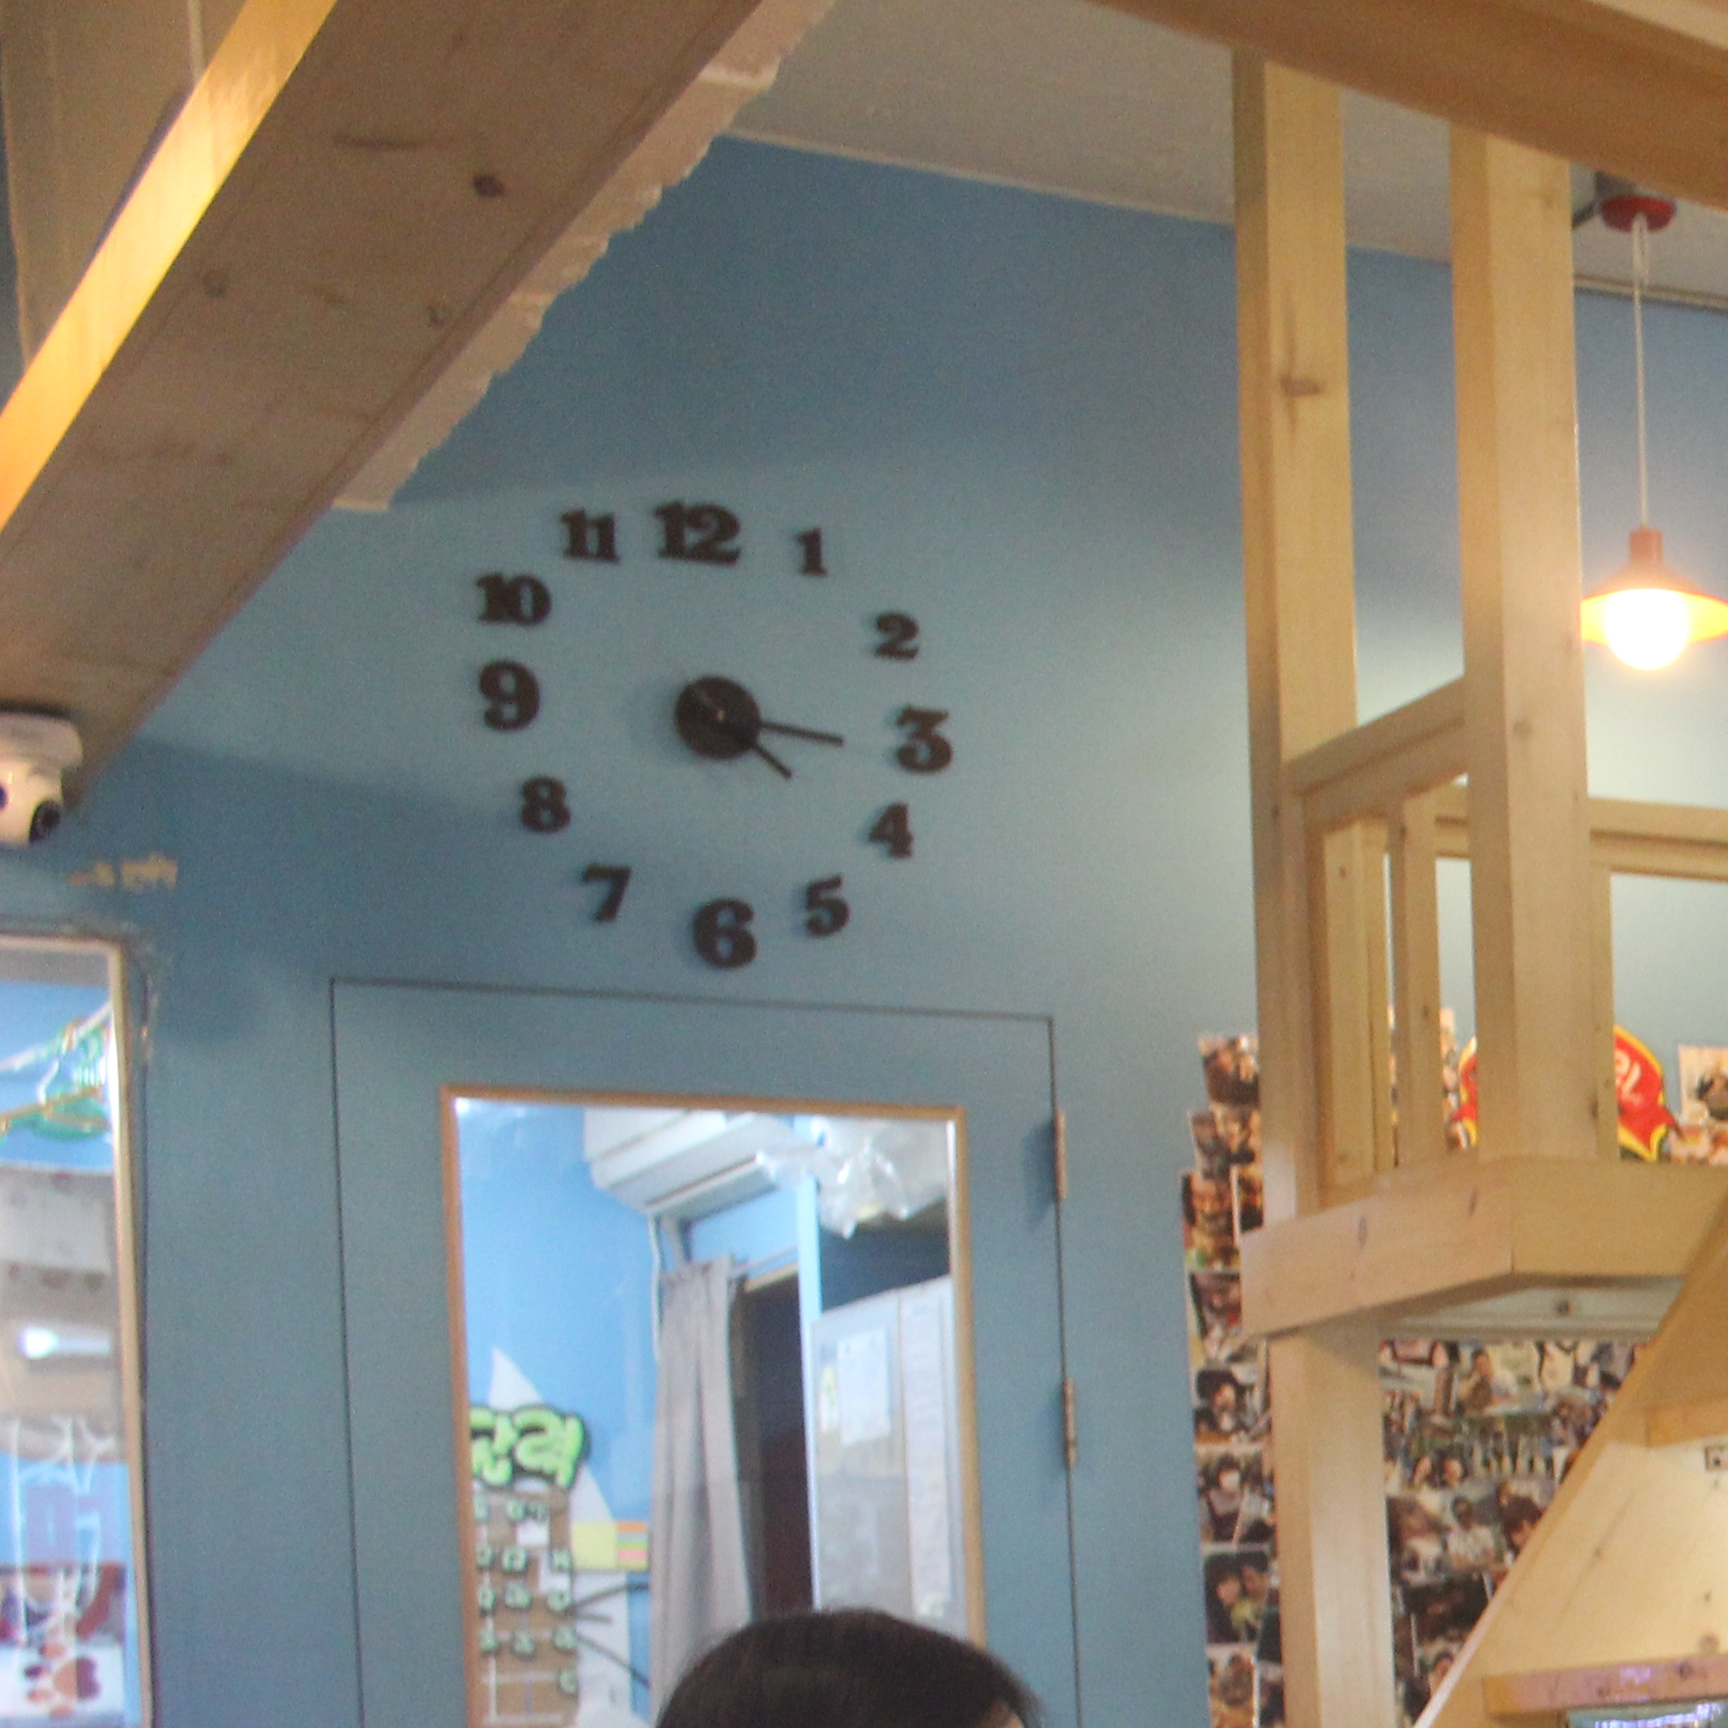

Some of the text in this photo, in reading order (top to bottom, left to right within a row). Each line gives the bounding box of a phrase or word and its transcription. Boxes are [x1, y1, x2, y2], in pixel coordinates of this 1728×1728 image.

[560, 509, 620, 564] 11
[654, 501, 742, 565] 12
[795, 528, 827, 577] 1
[476, 572, 551, 626] 10
[873, 611, 919, 660] 2
[478, 658, 541, 731] 9
[897, 705, 953, 774] 3
[519, 776, 571, 833] 8
[868, 803, 913, 859] 4
[581, 862, 632, 923] 7
[803, 875, 850, 937] 5
[692, 898, 757, 969] 6
